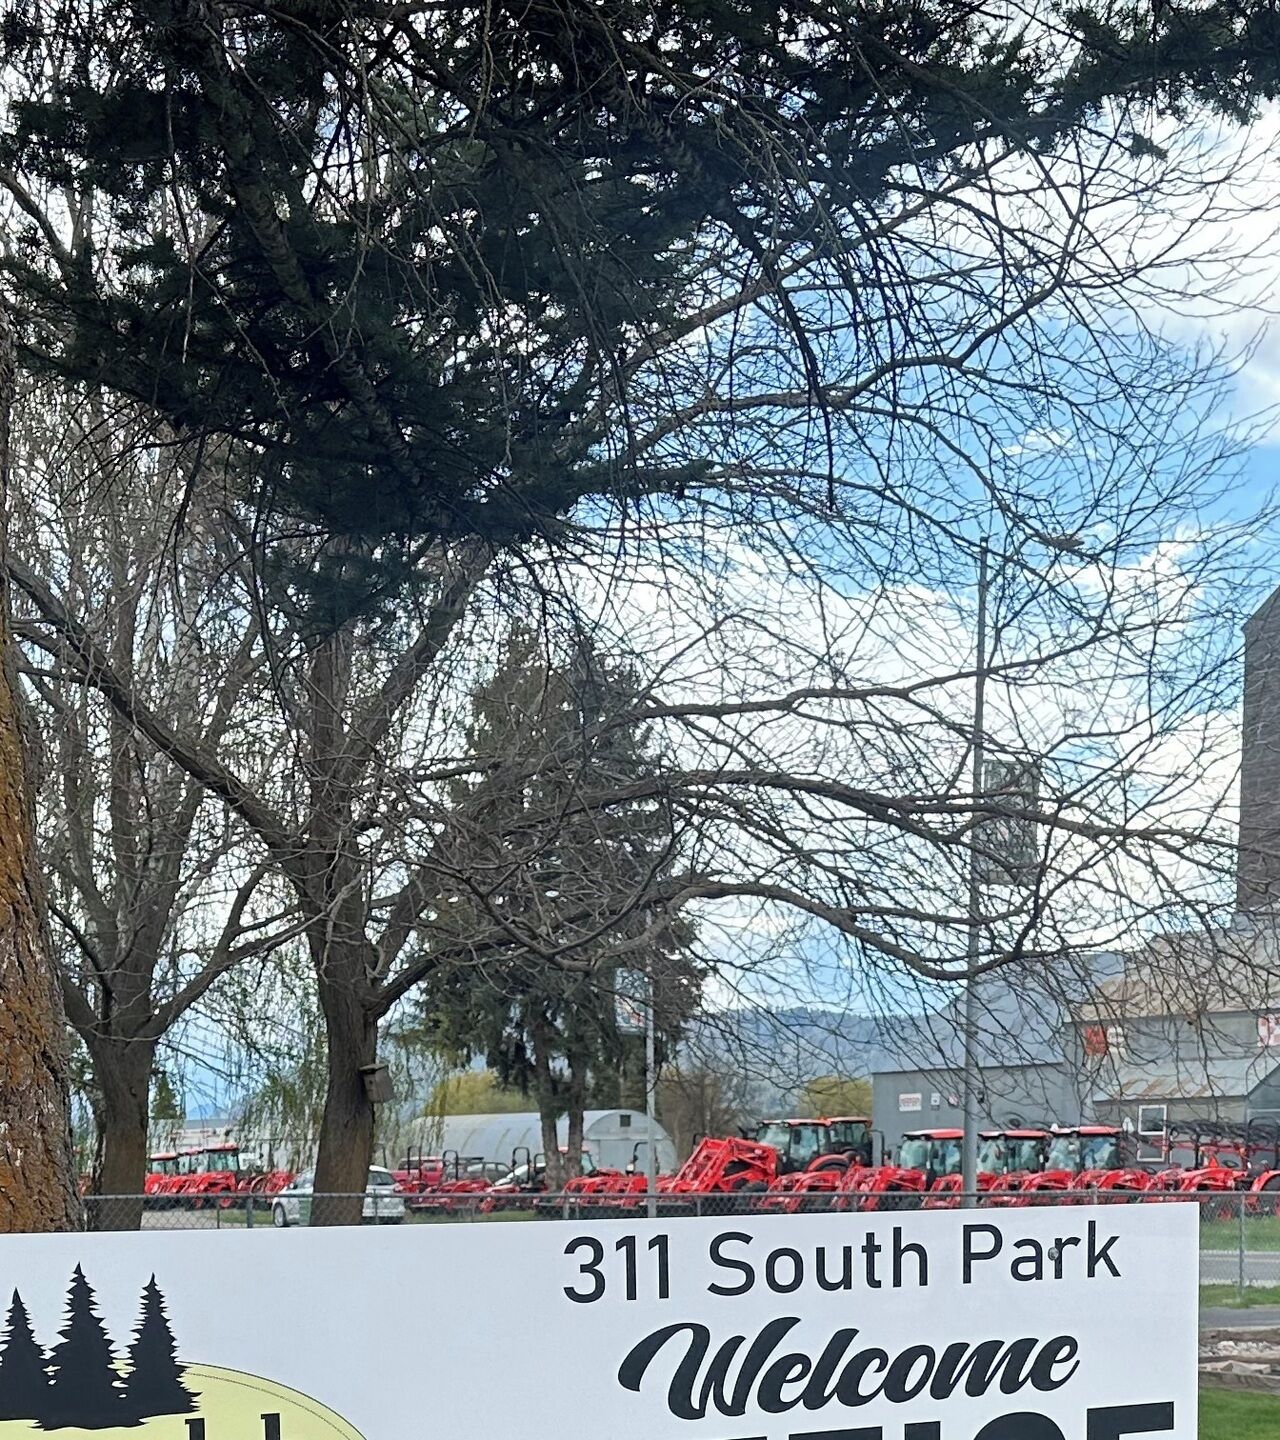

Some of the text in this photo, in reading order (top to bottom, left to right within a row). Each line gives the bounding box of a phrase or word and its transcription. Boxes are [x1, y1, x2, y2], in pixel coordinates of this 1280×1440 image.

[563, 1220, 1123, 1305] 311 South Park
[617, 1316, 1081, 1421] Welcome
